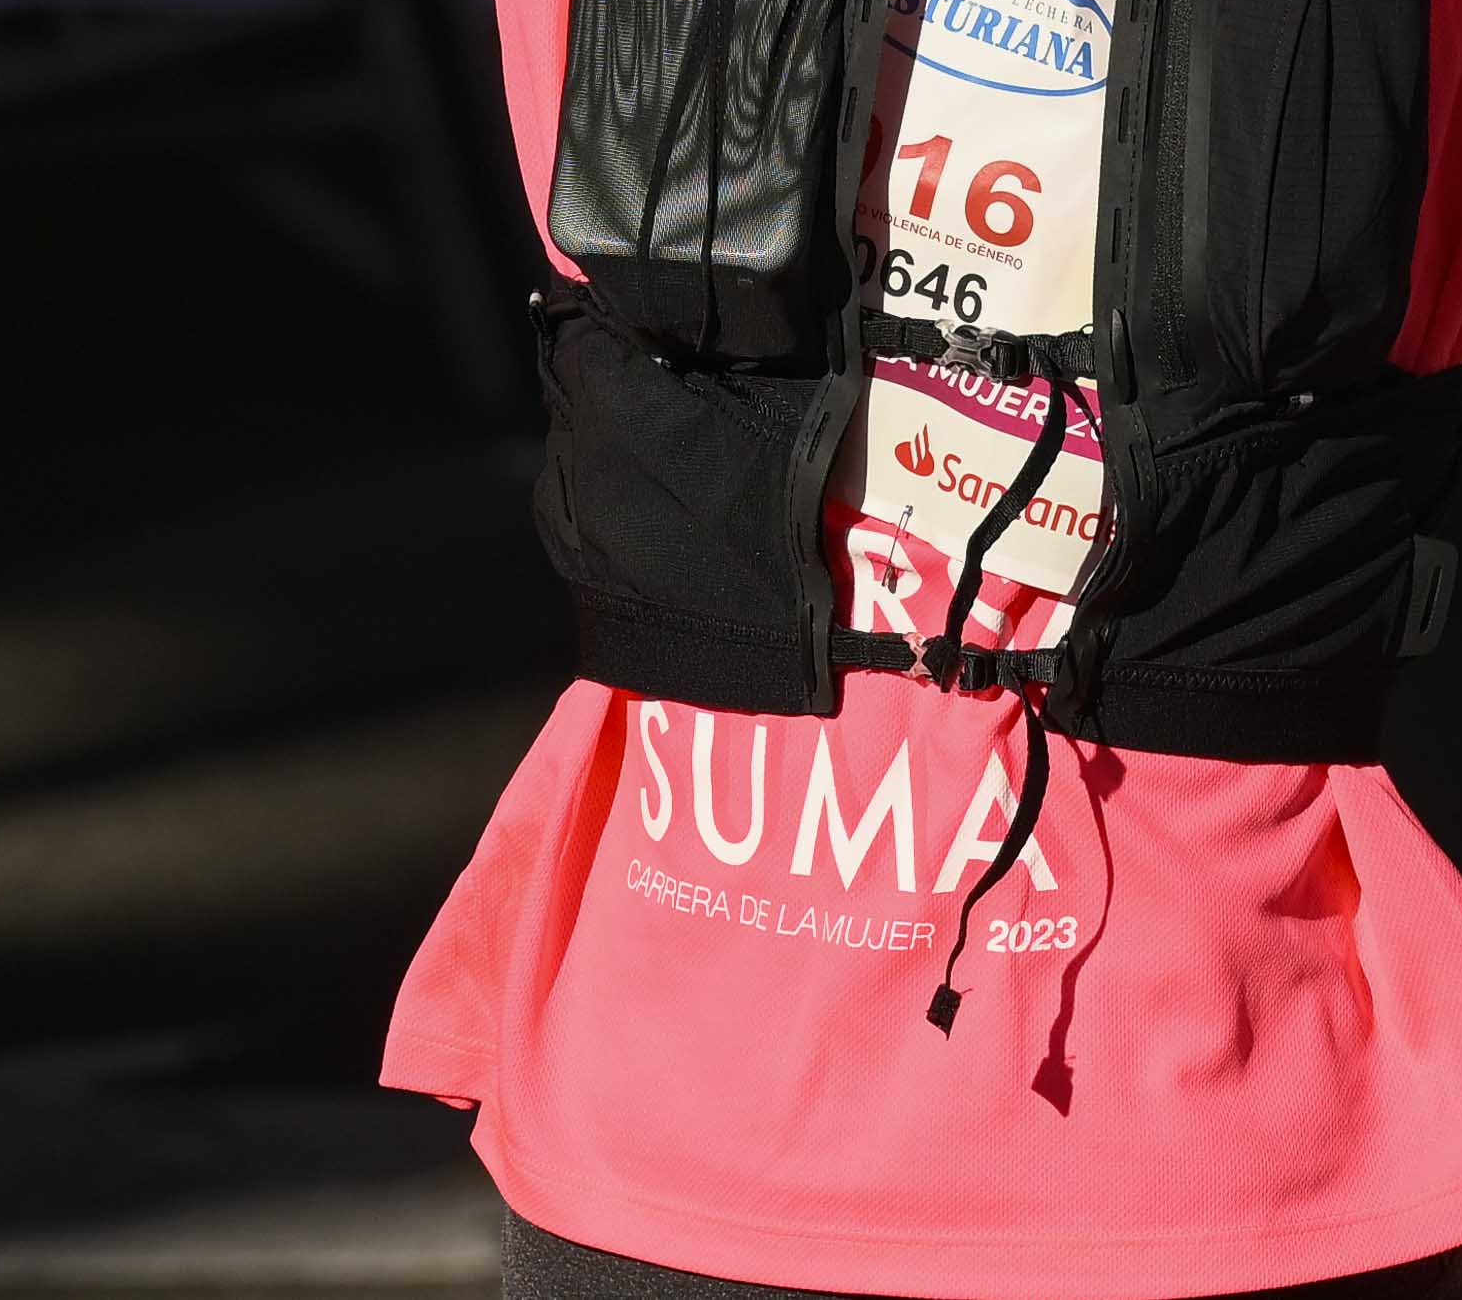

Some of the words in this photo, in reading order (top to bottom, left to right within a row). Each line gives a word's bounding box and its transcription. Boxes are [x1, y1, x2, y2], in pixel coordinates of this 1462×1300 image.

[871, 207, 941, 242] VIOLENCIA
[944, 234, 963, 249] DE
[966, 242, 1023, 270] GÉNERO
[638, 702, 1059, 894] SUMA
[626, 859, 731, 922] CARRERA
[739, 893, 771, 933] DE
[777, 904, 817, 940] LA
[822, 915, 936, 951] MUJER
[985, 916, 1078, 953] 2023
